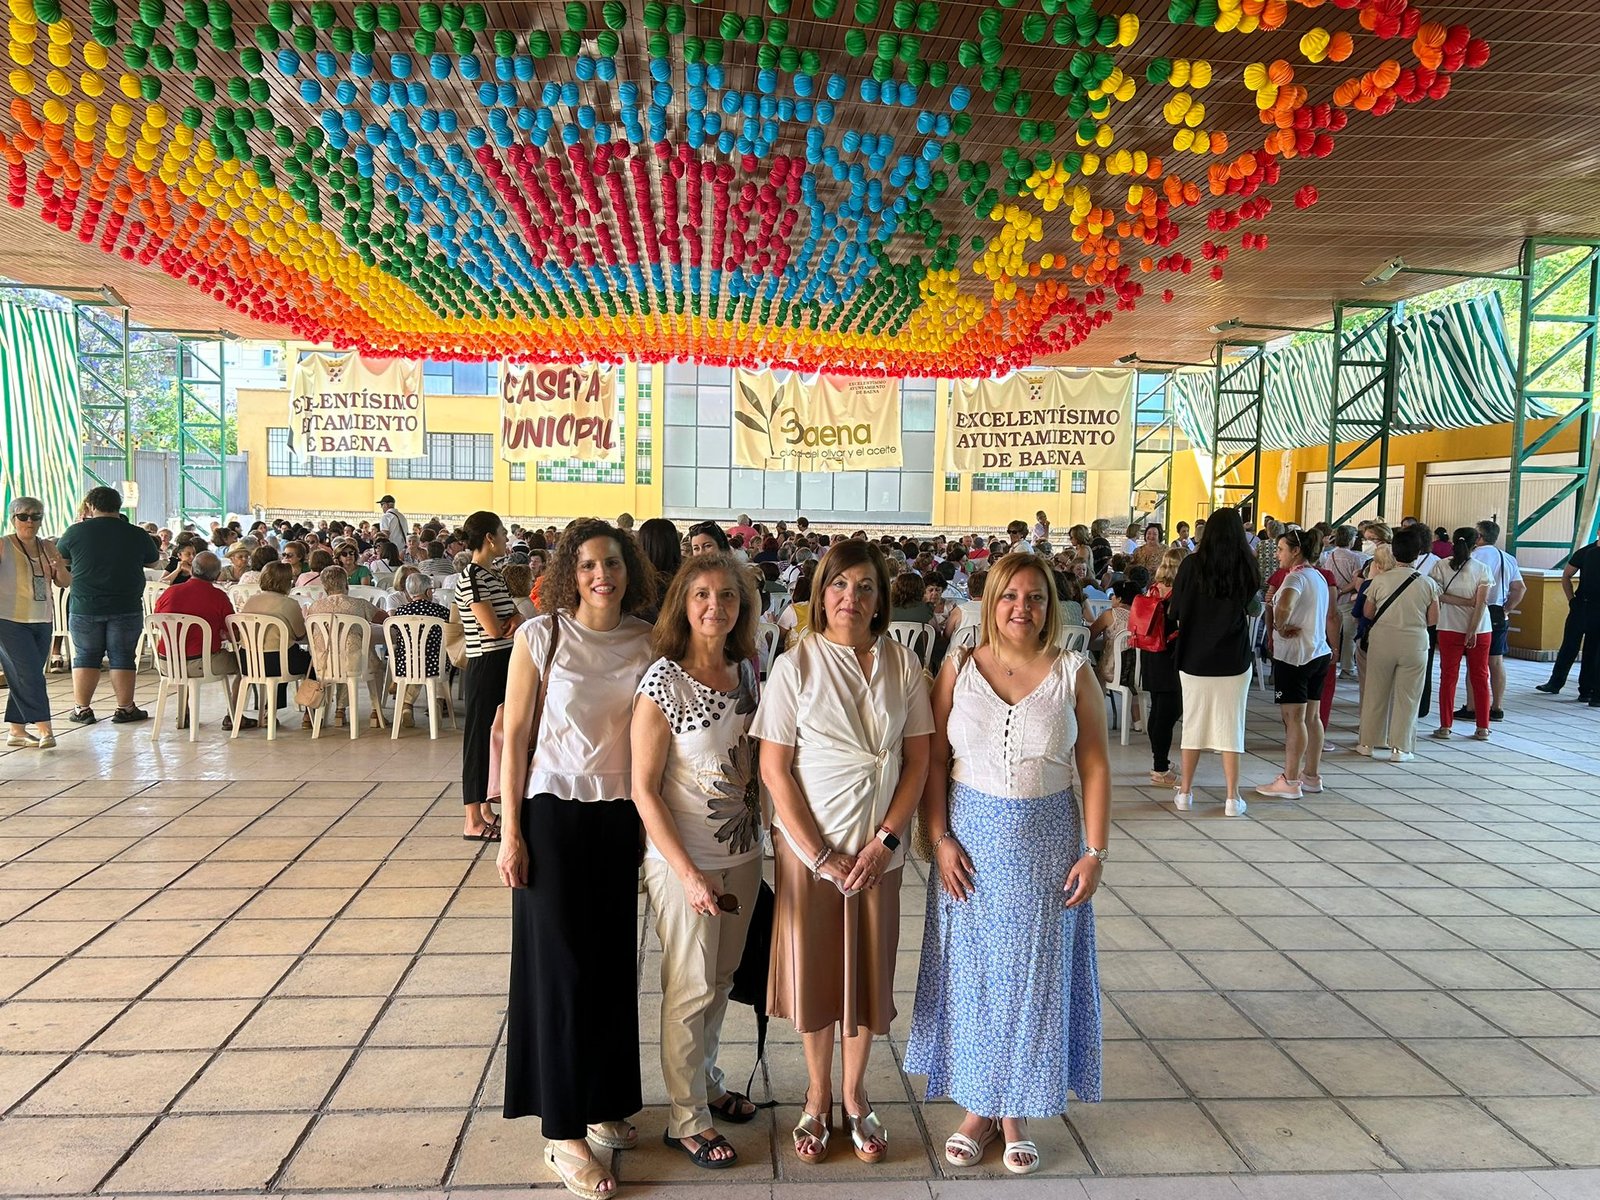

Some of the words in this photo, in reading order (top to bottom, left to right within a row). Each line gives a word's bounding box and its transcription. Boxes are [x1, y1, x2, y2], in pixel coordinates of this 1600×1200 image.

[503, 367, 600, 404] CASETA
[955, 405, 1121, 428] EXCELENTÍSIMO
[320, 435, 392, 452] BAENA
[956, 429, 1116, 449] AYUNTAMIENTO
[847, 449, 854, 458] y
[856, 447, 865, 456] el
[867, 445, 897, 455] aceite
[982, 452, 1012, 468] DE
[1018, 450, 1086, 467] BAENA
